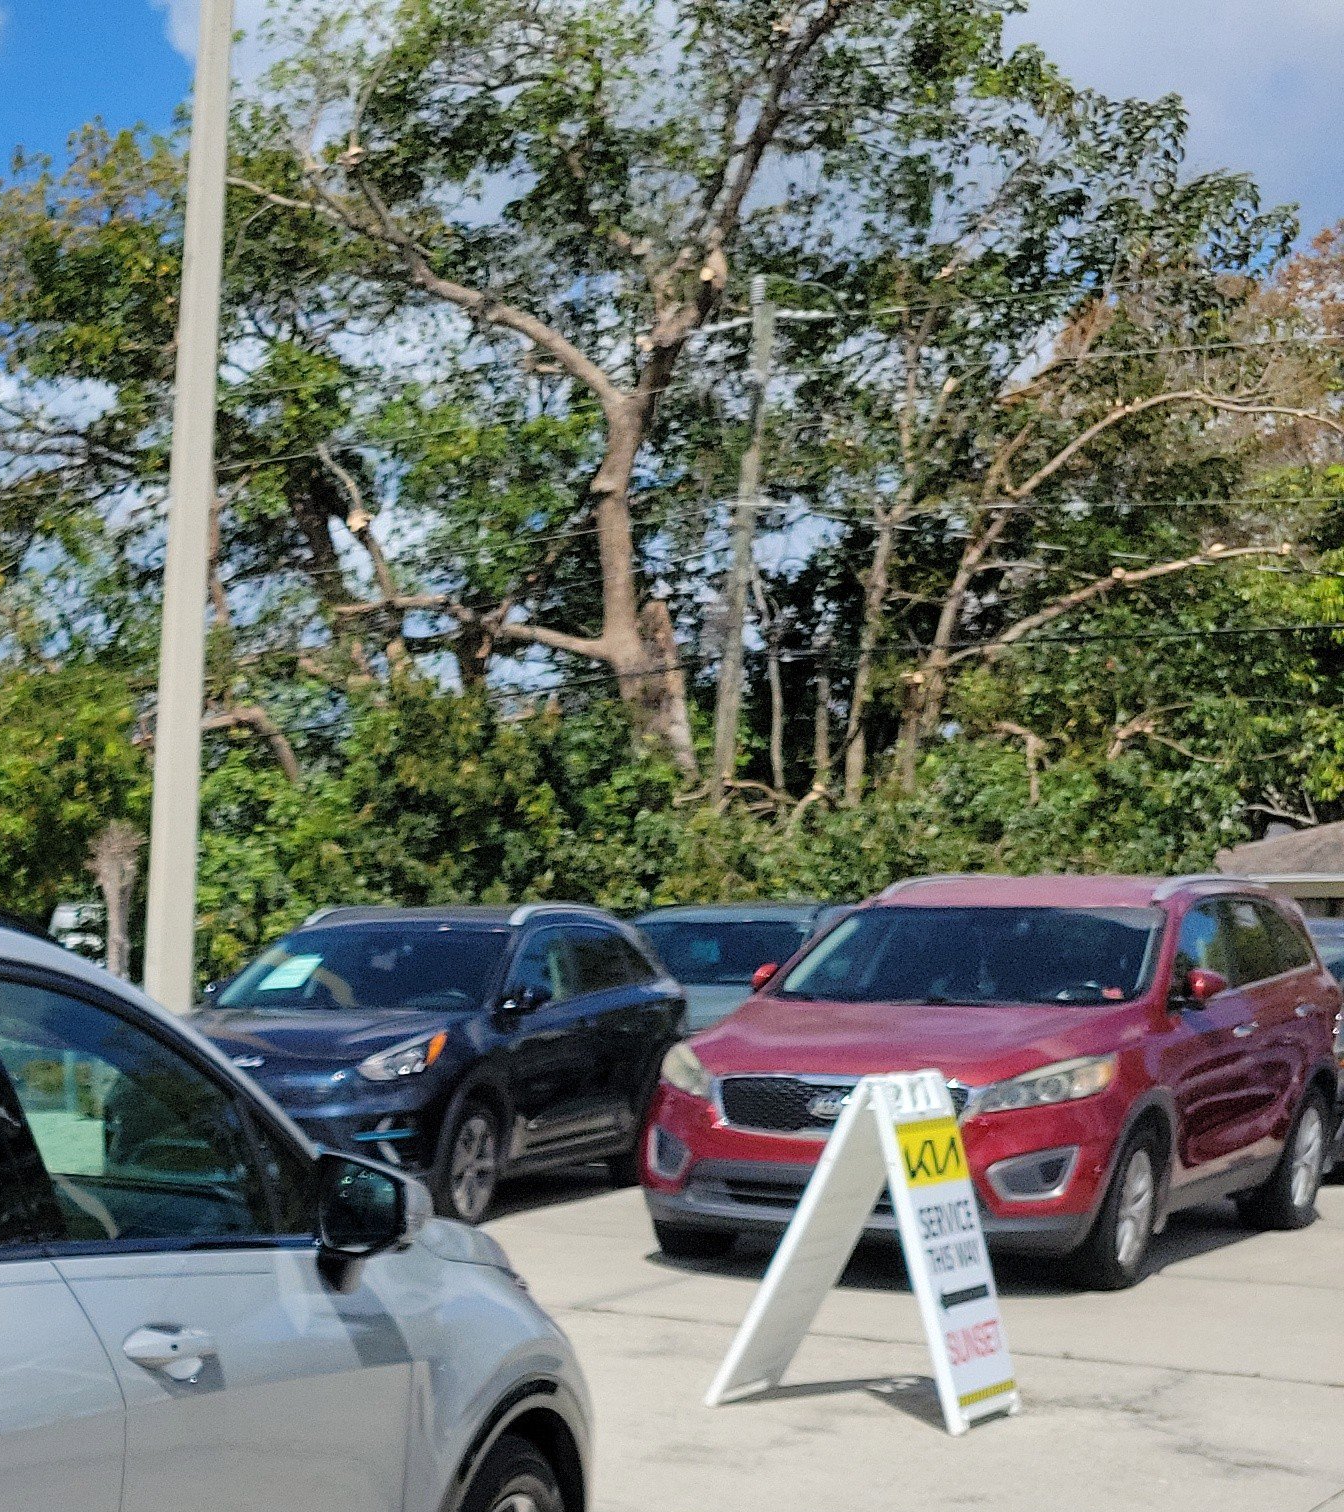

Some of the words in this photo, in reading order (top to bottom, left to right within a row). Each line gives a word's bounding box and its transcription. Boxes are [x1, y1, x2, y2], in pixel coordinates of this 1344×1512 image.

[904, 1136, 961, 1179] KIA
[919, 1199, 976, 1240] SERVICE
[926, 1244, 955, 1274] THIS
[955, 1238, 981, 1268] WAY
[945, 1320, 1000, 1365] SUNSET
